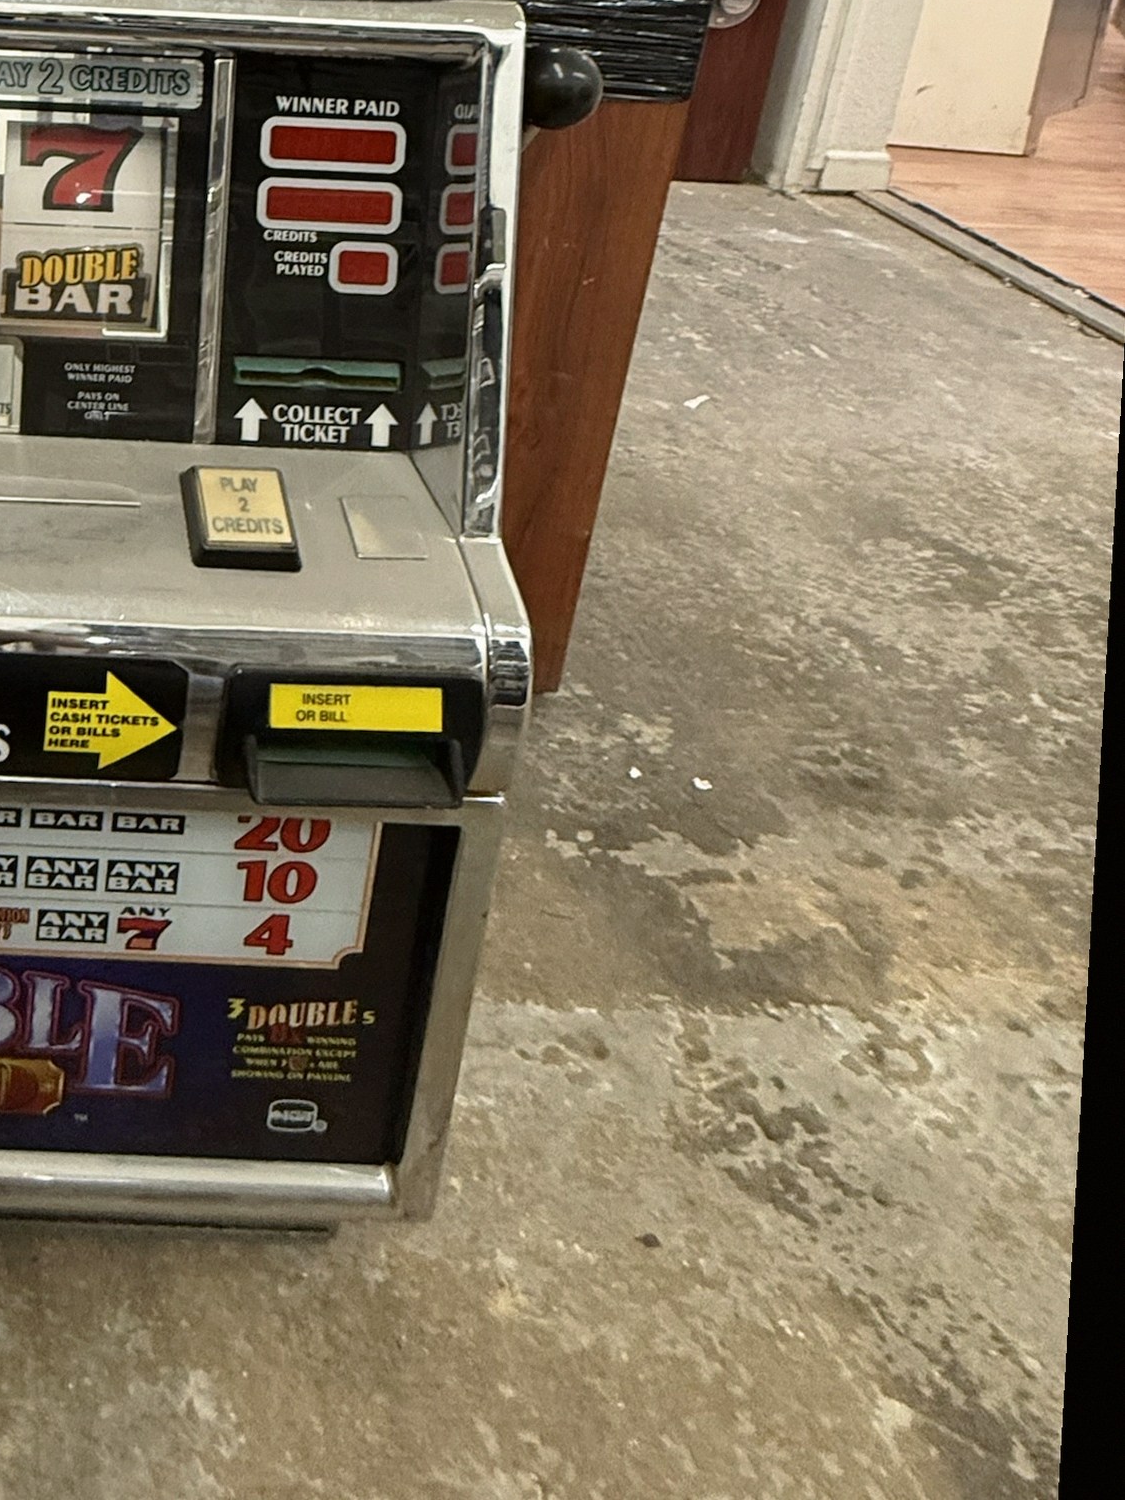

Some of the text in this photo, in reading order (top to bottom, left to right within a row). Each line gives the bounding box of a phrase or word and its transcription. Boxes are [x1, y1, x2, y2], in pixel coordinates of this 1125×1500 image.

[38, 58, 64, 94] 2
[69, 64, 191, 95] CREDITS
[275, 96, 400, 117] WINNER PAID
[20, 123, 144, 213] 7
[263, 229, 318, 243] CREDITS
[274, 250, 328, 263] CREDITS
[20, 247, 141, 288] DOUBLE
[276, 264, 325, 276] PLAYED
[13, 283, 133, 315] BAR
[64, 362, 136, 374] ONLY HIGHEST
[107, 373, 133, 383] PAID
[77, 390, 102, 401] PAYS
[272, 403, 361, 425] COLLECT
[281, 423, 351, 444] TICKET
[219, 477, 258, 492] PLAY
[237, 497, 250, 512] 2
[212, 515, 284, 535] CREDITS
[51, 697, 110, 710] INSERT
[302, 693, 352, 706] INSERT
[50, 712, 160, 726] CASH TICKETS
[296, 710, 348, 722] OR BILL
[48, 726, 121, 738] OR BILLS
[48, 738, 90, 749] HERE
[234, 815, 332, 853] 20
[237, 859, 318, 904] 10
[243, 913, 294, 956] 4
[246, 999, 359, 1031] DOUBLE
